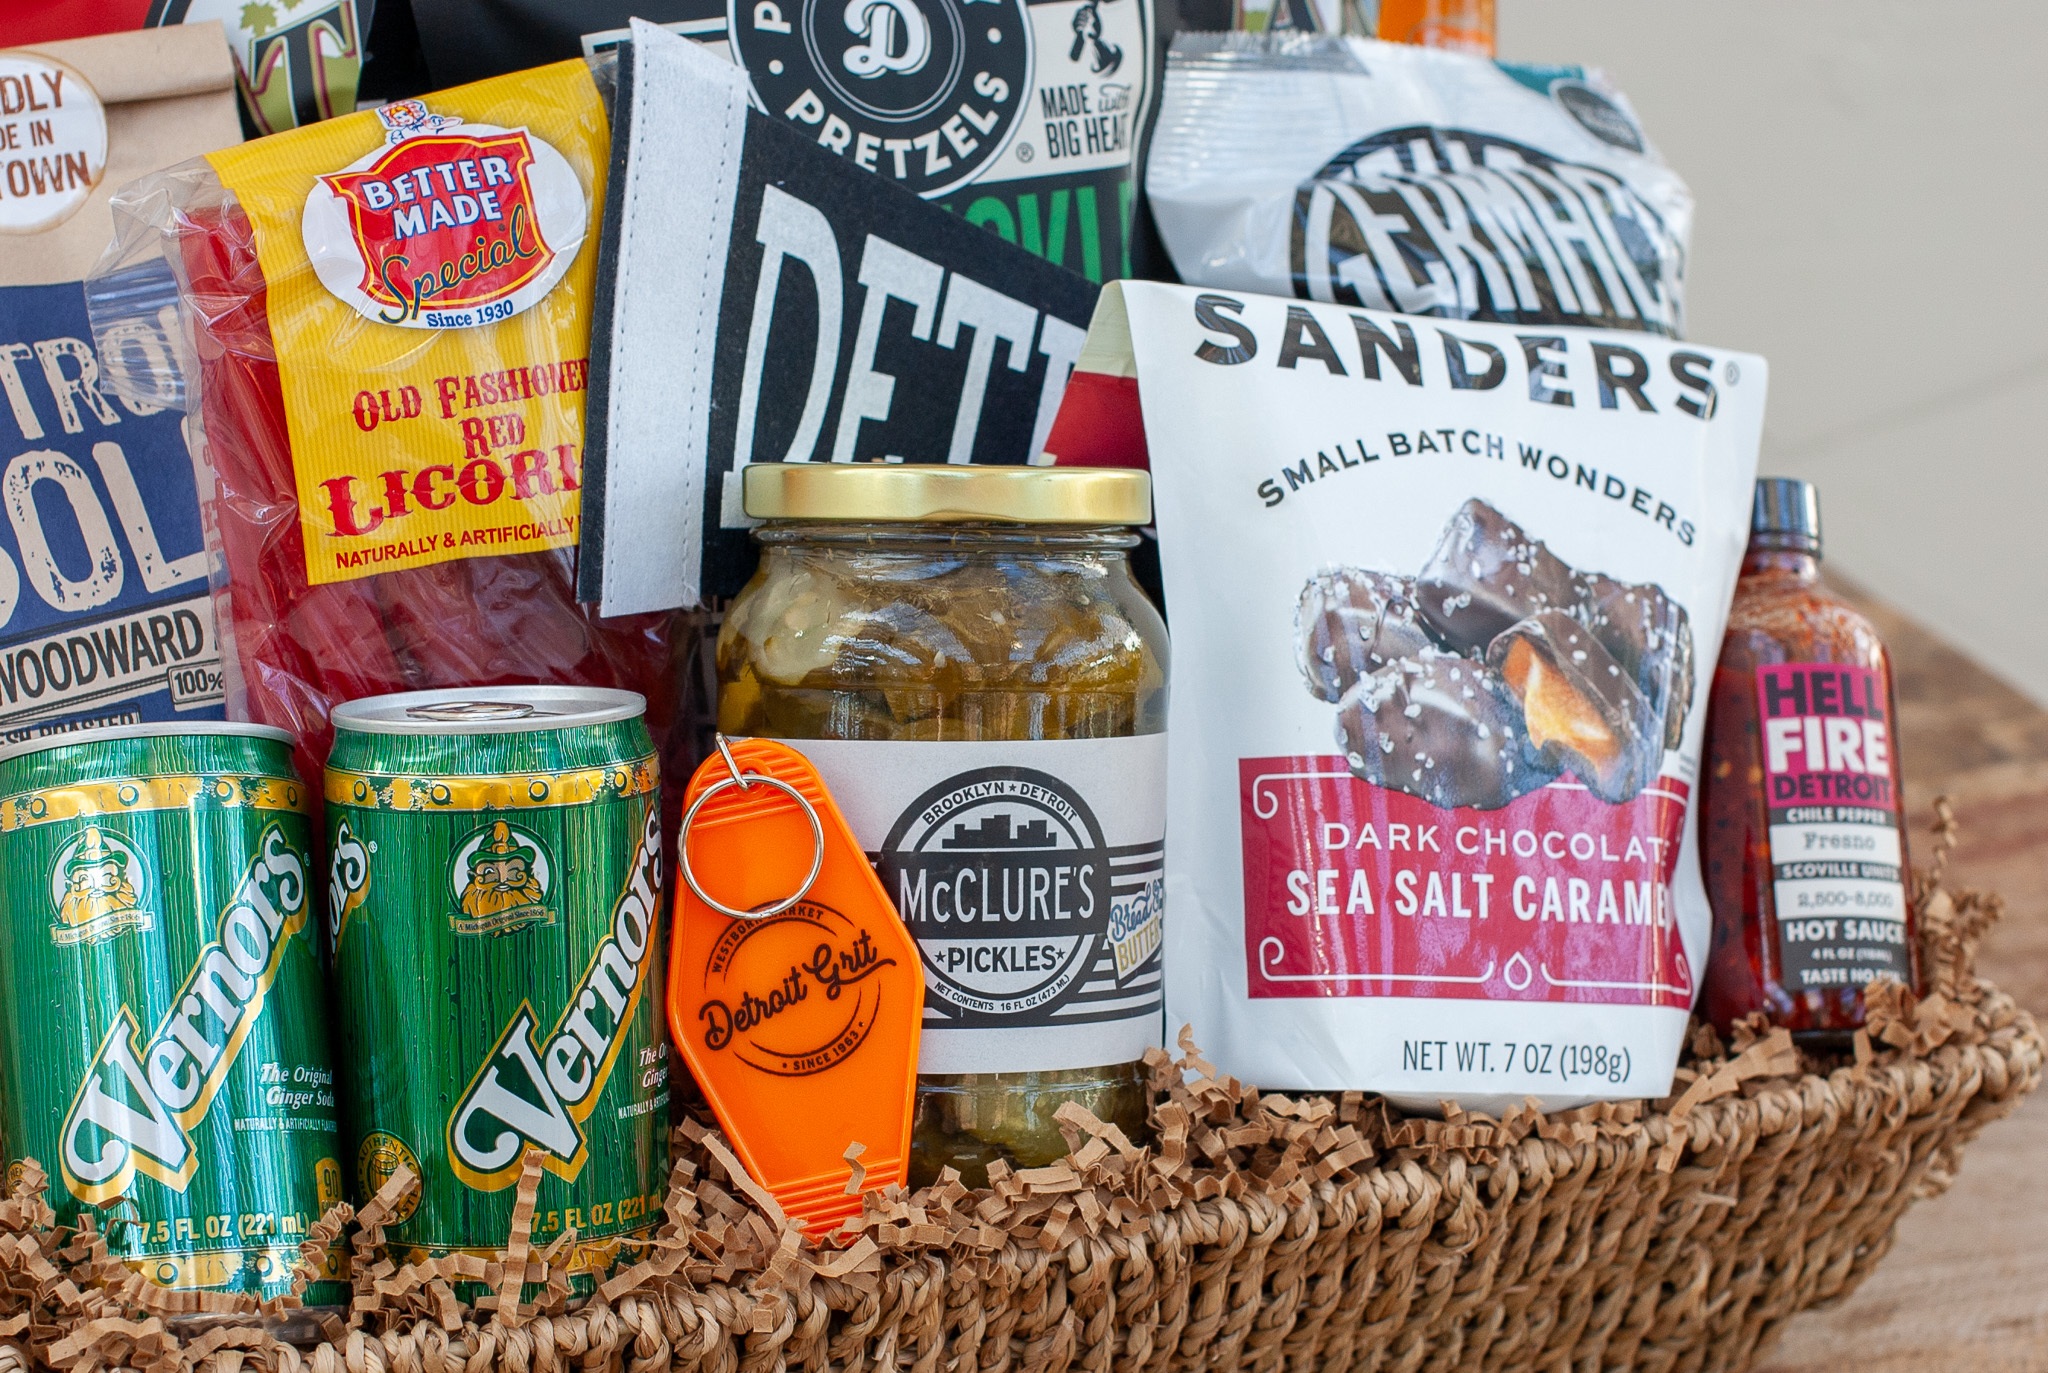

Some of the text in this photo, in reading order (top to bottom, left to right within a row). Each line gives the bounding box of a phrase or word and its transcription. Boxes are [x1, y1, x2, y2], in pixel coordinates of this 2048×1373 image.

[1041, 84, 1092, 118] MADE
[30, 119, 54, 146] IN
[785, 71, 1010, 179] PRETZELS
[1046, 120, 1081, 158] BIG
[0, 151, 92, 198] OWN
[362, 155, 515, 211] BETTER
[393, 193, 503, 240] MADE
[379, 203, 537, 325] Special
[427, 300, 514, 328] Since 1930
[1194, 294, 1718, 422] SANDERS
[352, 385, 422, 432] OLD
[458, 412, 526, 459] RED
[1256, 430, 1697, 548] SMALL BATCH WONDERS
[336, 520, 575, 569] NATURALLY & ARTIFICIALLY
[174, 668, 224, 696] 100%
[1765, 672, 1884, 719] HELL
[1766, 717, 1890, 776] FIRE
[921, 782, 1078, 826] BROOKLYN DETROIT
[1774, 774, 1890, 803] DETROIT
[1786, 806, 1835, 823] CHILE
[1324, 822, 1440, 853] DARK
[1782, 863, 1859, 880] SCOVILLE
[1110, 881, 1152, 942] Bread
[1286, 869, 1375, 917] SEA
[1395, 871, 1494, 919] SALT
[1117, 913, 1160, 973] BUTTER
[1786, 920, 1905, 945] HOT SAUCE
[947, 945, 1057, 973] PICKLES
[1800, 967, 1848, 985] TASTE
[66, 828, 306, 1184] Vernors
[454, 811, 663, 1170] Vernors
[699, 929, 897, 1051] Detroit Grit
[934, 981, 951, 997] NET
[952, 992, 994, 1010] CONTENTS
[1000, 1002, 1012, 1011] 16
[1014, 1001, 1024, 1010] FL
[1026, 996, 1038, 1007] OZ
[1038, 986, 1057, 1003] (473
[640, 1047, 657, 1067] The
[793, 1030, 859, 1071] SINCE 1963
[1403, 1041, 1632, 1084] NET WT. 7 OZ (198g)
[260, 1062, 333, 1089] The Original
[266, 1085, 335, 1110] Ginger Soda
[234, 1117, 277, 1131] NATURALLY
[323, 1167, 339, 1198] 90
[141, 1211, 310, 1244] 7.5 FL OZ (221 mL)
[531, 1211, 559, 1233] 7.5
[565, 1207, 587, 1229] FL
[591, 1202, 613, 1226] OZ
[618, 1194, 646, 1225] (221
